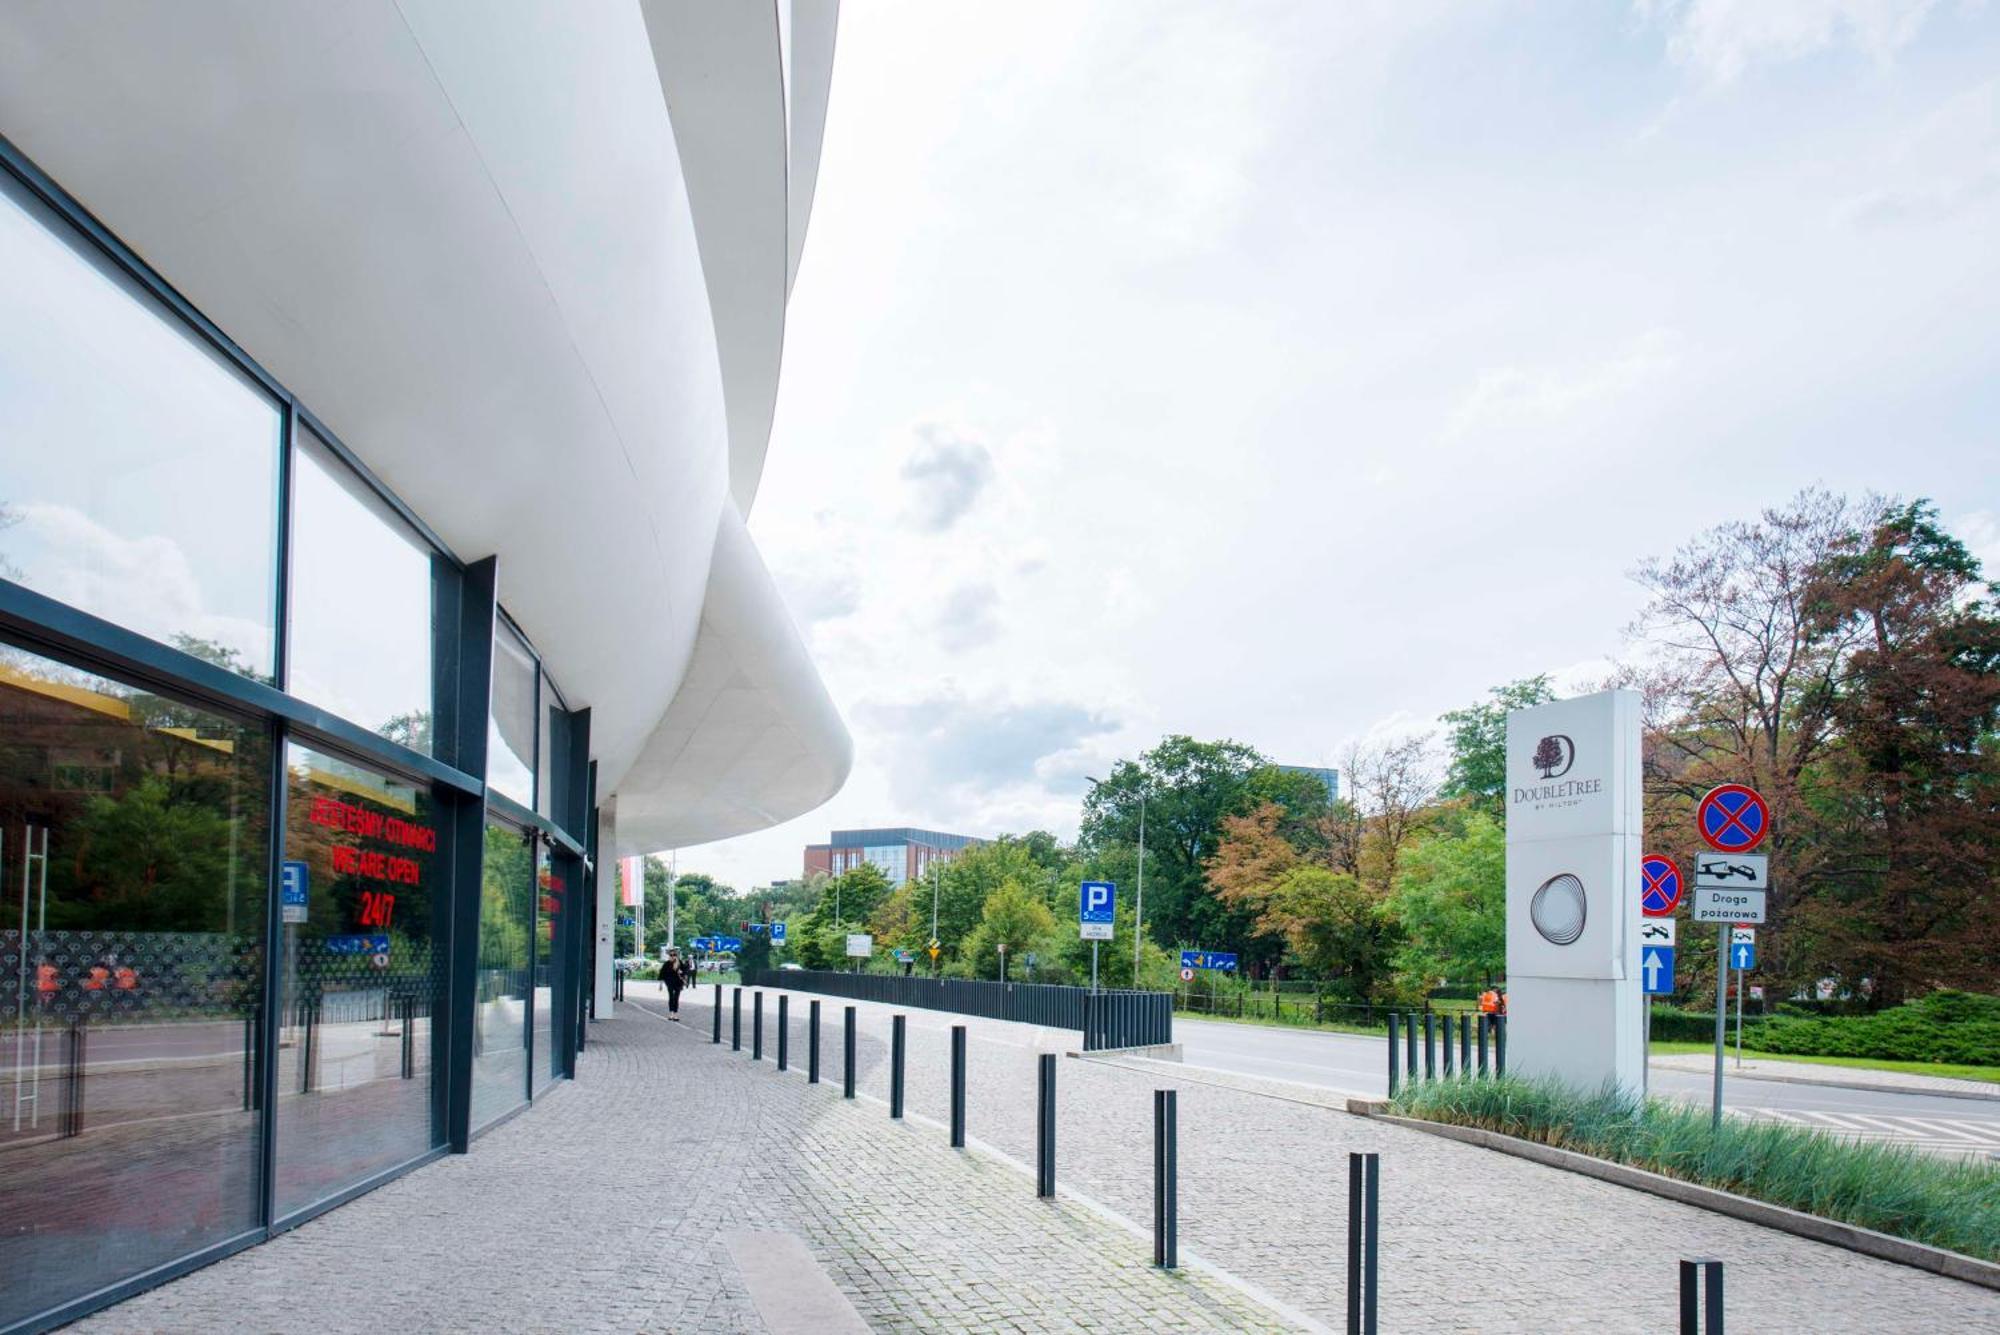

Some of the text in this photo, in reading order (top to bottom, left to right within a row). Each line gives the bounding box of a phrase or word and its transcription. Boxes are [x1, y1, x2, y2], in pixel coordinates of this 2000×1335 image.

[1513, 779, 1601, 803] DOUBLETREE
[332, 844, 419, 885] WE ARE OPEN
[1088, 886, 1107, 911] P
[1712, 893, 1748, 906] Droga
